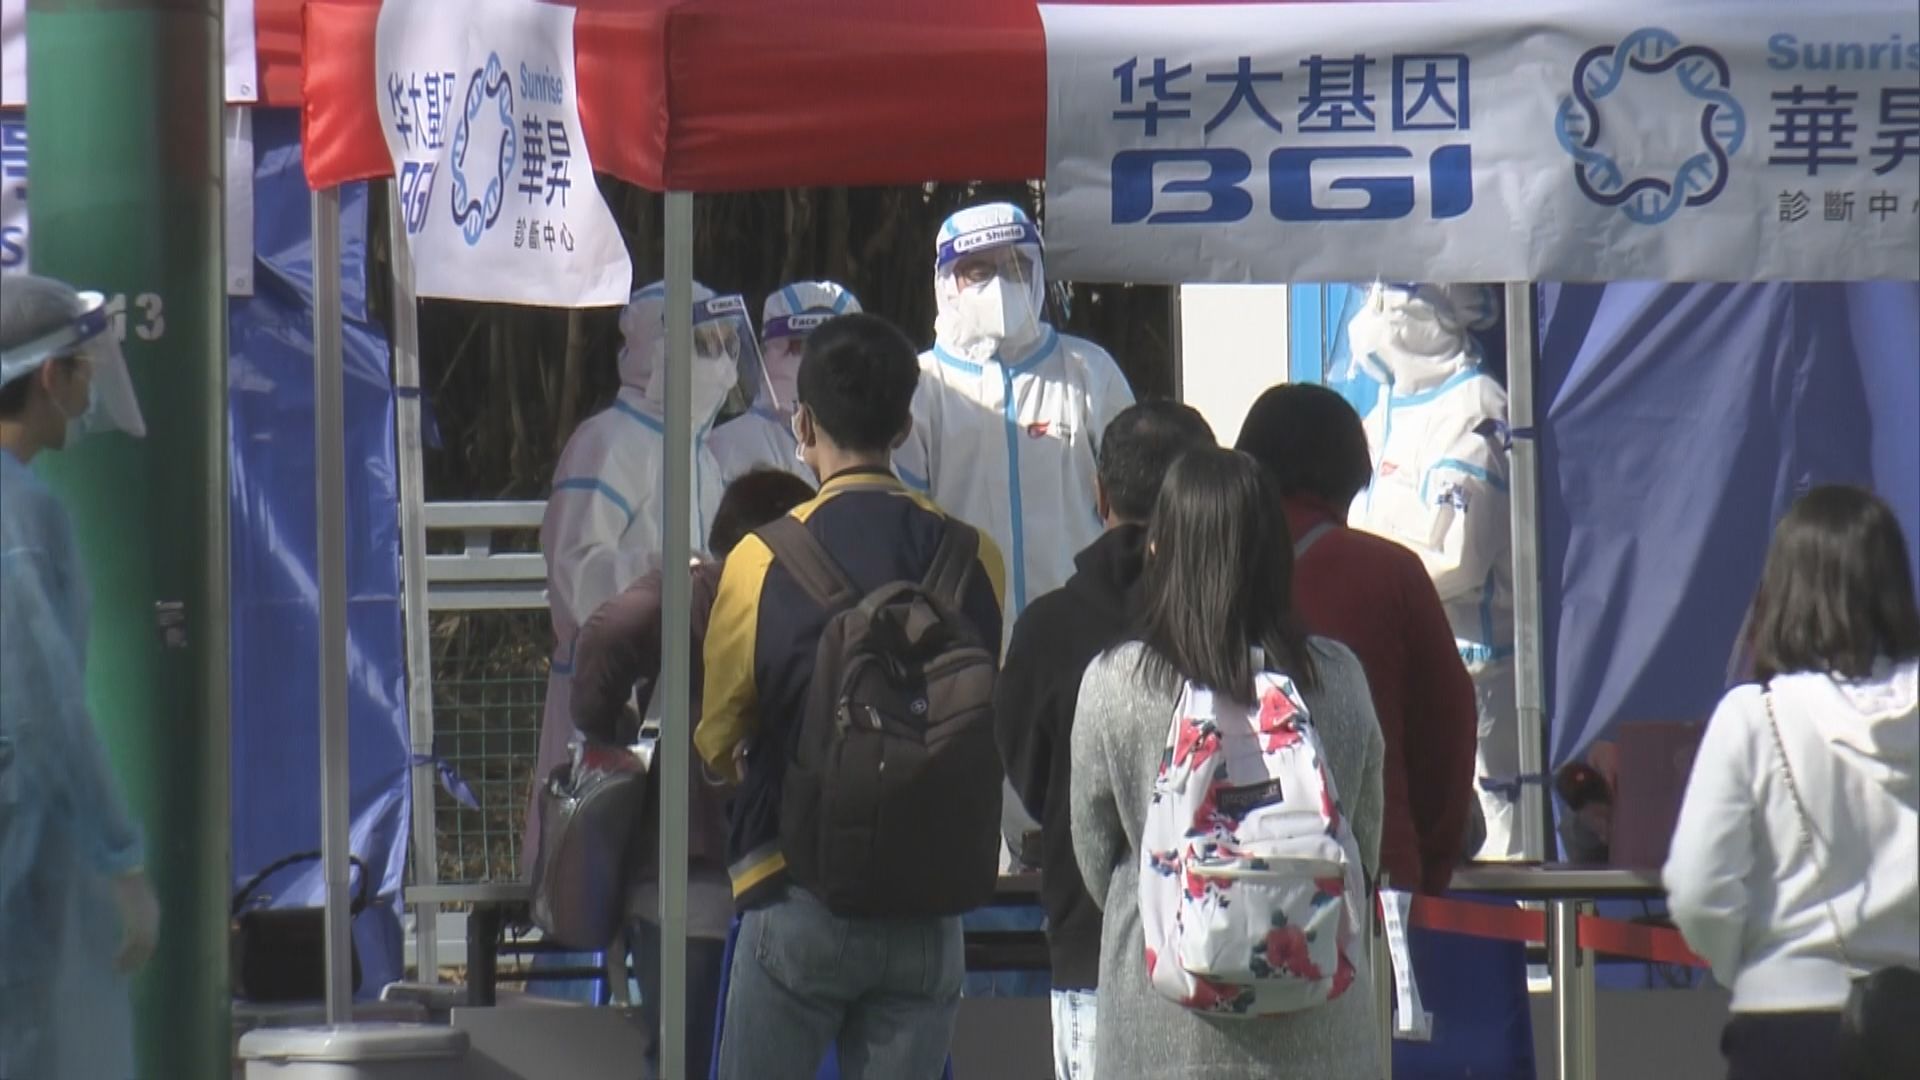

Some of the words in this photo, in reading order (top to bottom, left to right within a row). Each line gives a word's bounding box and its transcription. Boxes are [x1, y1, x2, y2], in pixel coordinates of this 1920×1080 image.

[520, 61, 563, 104] Sunrise
[1112, 54, 1470, 136] 华大基因
[518, 114, 571, 207] 華昇
[1111, 144, 1473, 224] BGI
[1778, 190, 1919, 222] 診斷中
[958, 233, 983, 249] Face
[985, 226, 1021, 241] Shield
